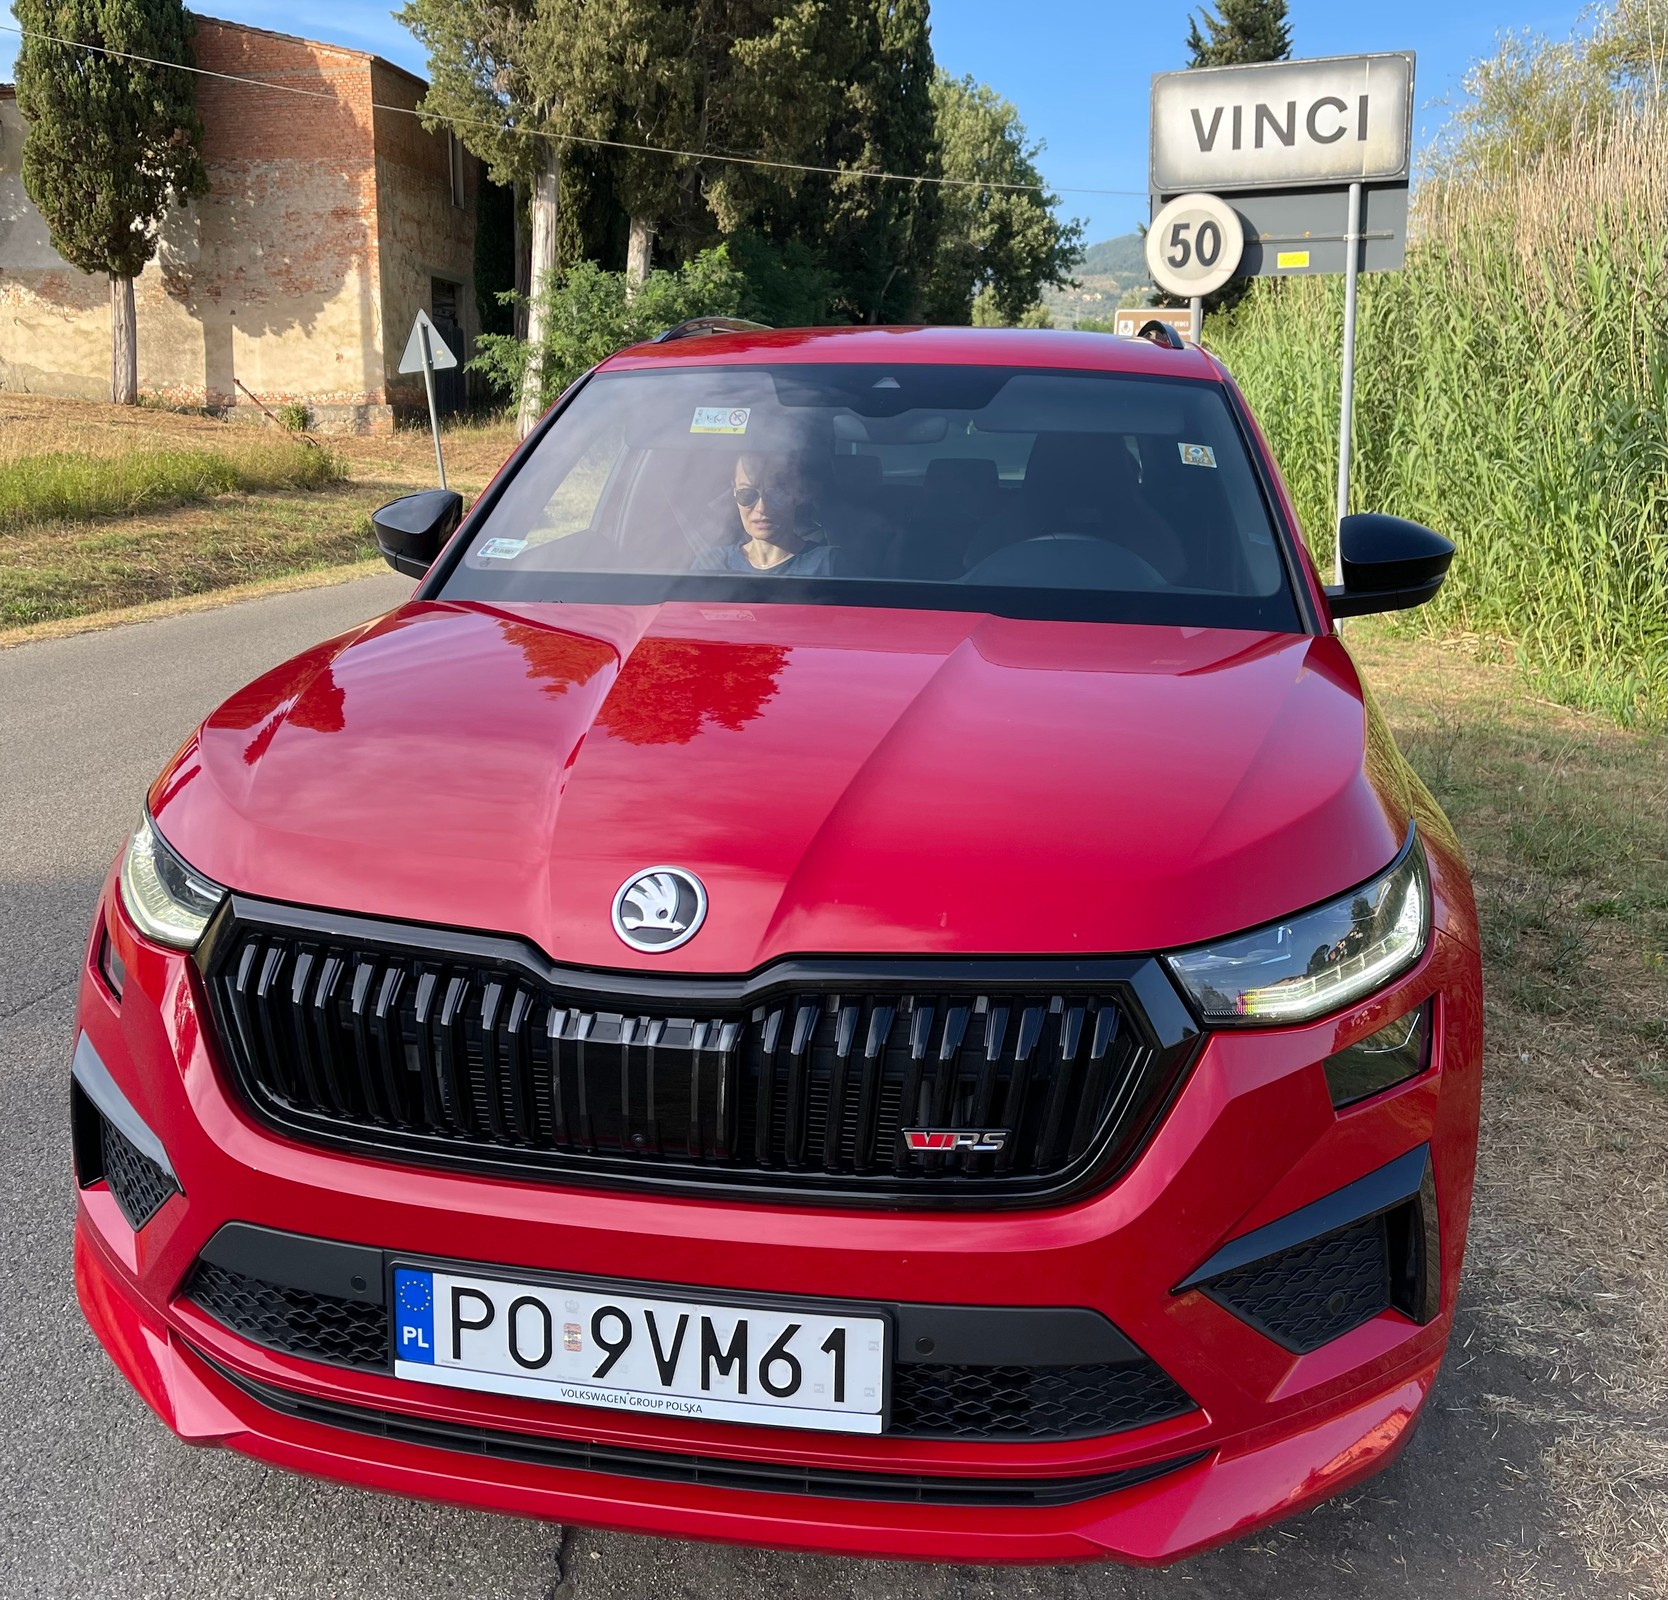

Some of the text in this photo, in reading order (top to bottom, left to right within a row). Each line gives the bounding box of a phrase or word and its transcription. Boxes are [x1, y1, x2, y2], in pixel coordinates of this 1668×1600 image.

[1190, 95, 1368, 152] VINCI
[1167, 220, 1222, 268] 50
[403, 1326, 429, 1348] PL
[451, 1286, 846, 1403] PO 9VM61
[561, 1388, 702, 1413] VOLKSWAGEN GROUP POLSKA
